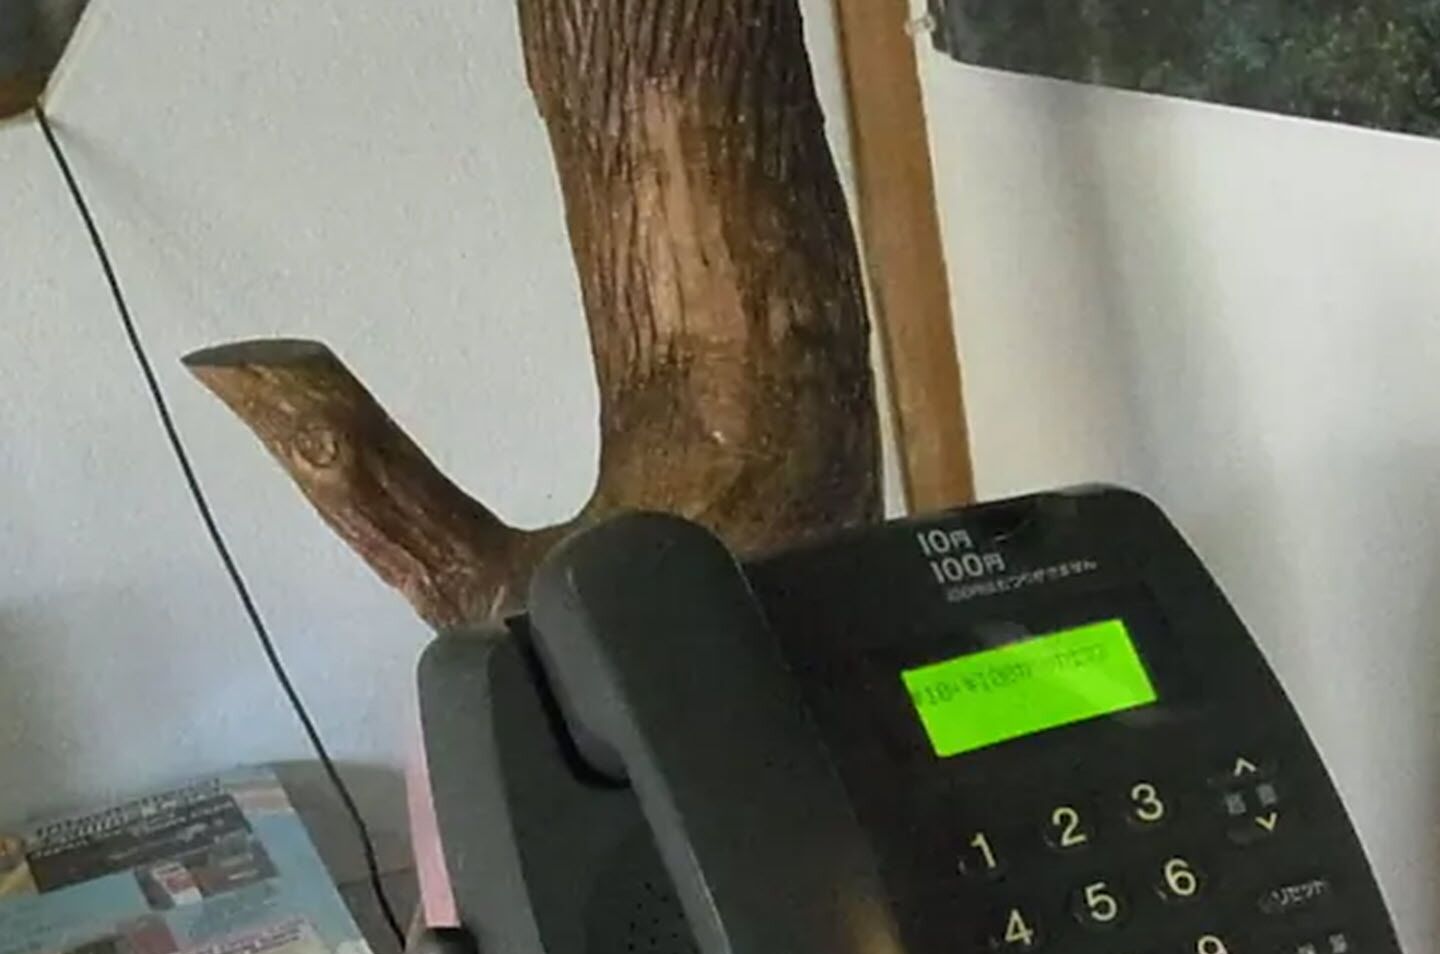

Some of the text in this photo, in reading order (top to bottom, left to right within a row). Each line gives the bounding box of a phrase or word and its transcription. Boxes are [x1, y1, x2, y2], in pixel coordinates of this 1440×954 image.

[917, 529, 973, 557] 10円
[930, 552, 1006, 584] 100円
[970, 783, 1164, 868] 1 2 3
[1005, 858, 1197, 946] 4 5 6
